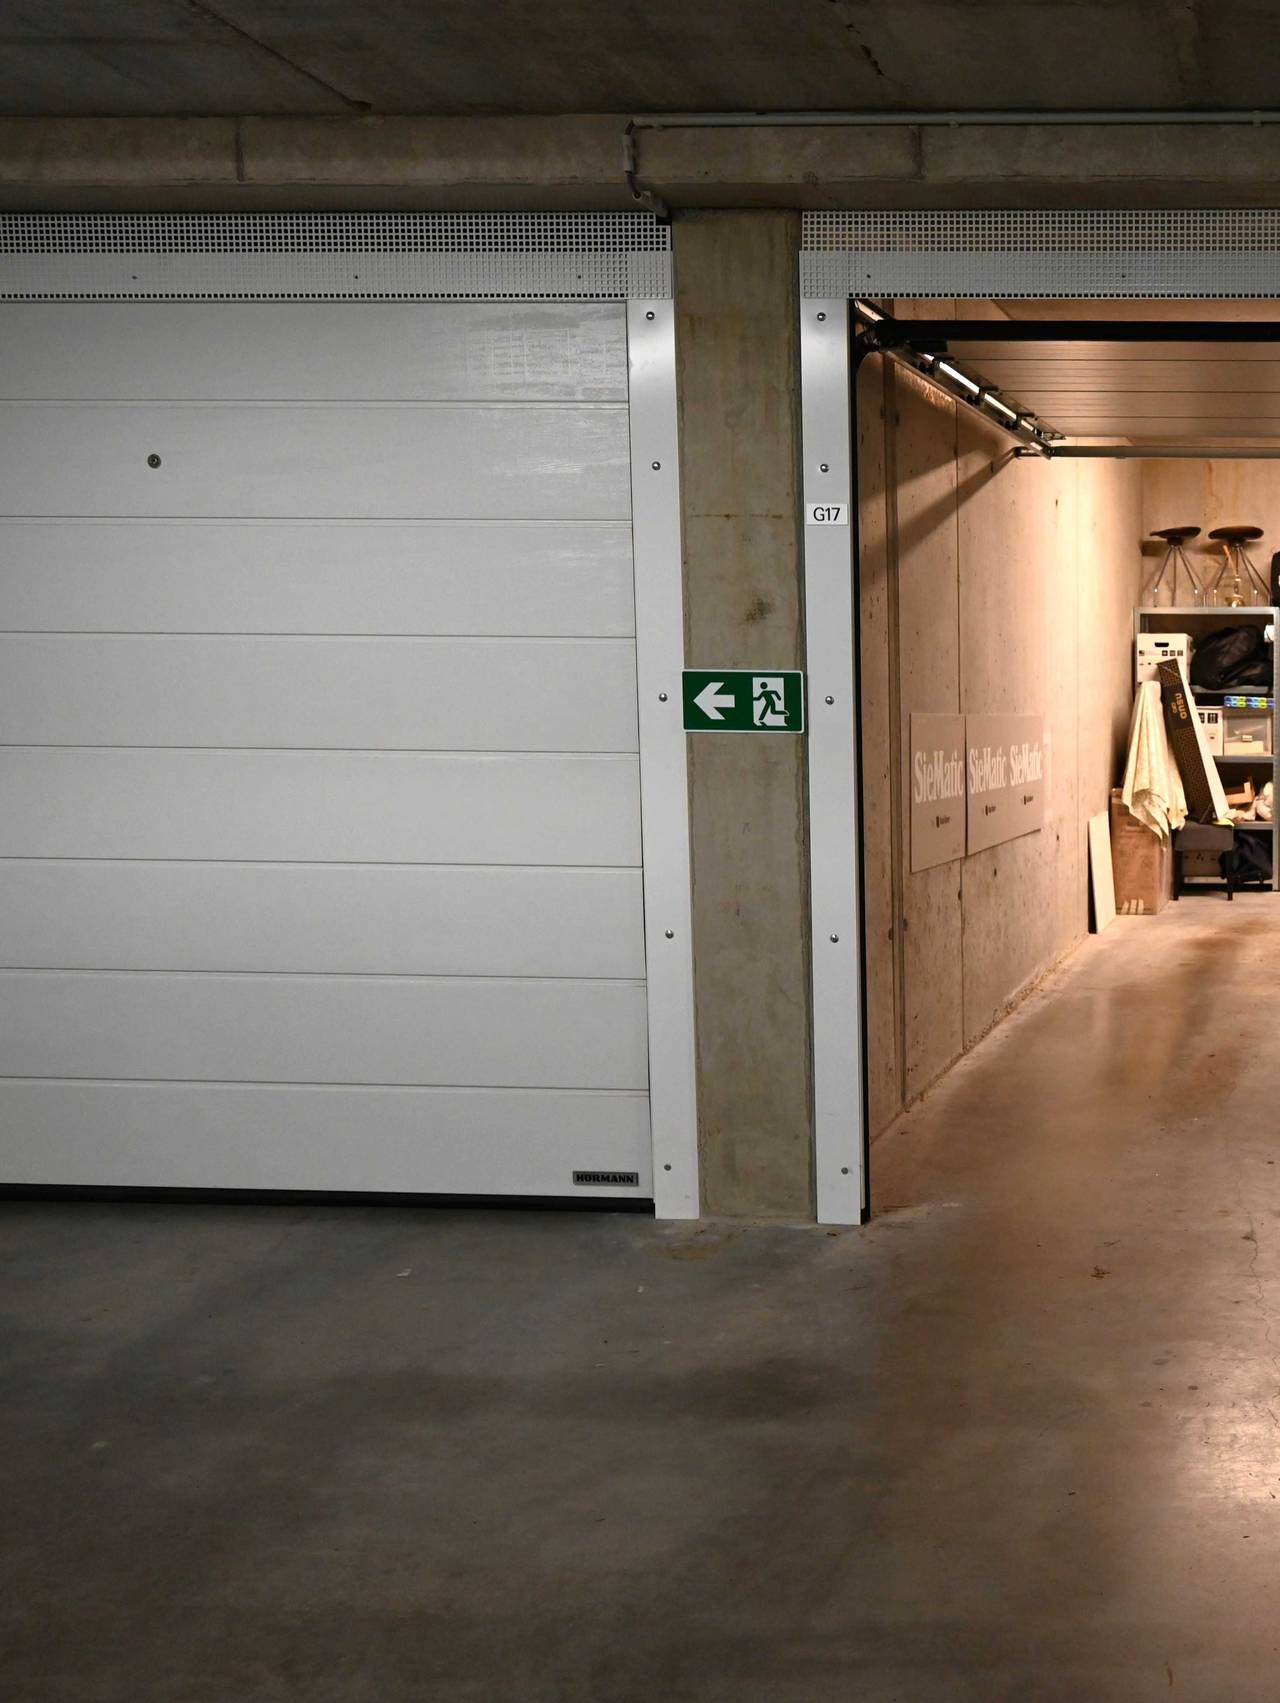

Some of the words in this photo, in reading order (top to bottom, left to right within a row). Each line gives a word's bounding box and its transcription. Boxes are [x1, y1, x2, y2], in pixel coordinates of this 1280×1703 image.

[813, 506, 841, 521] G17
[915, 750, 964, 803] SieMatic
[969, 746, 1006, 794] SieMatic
